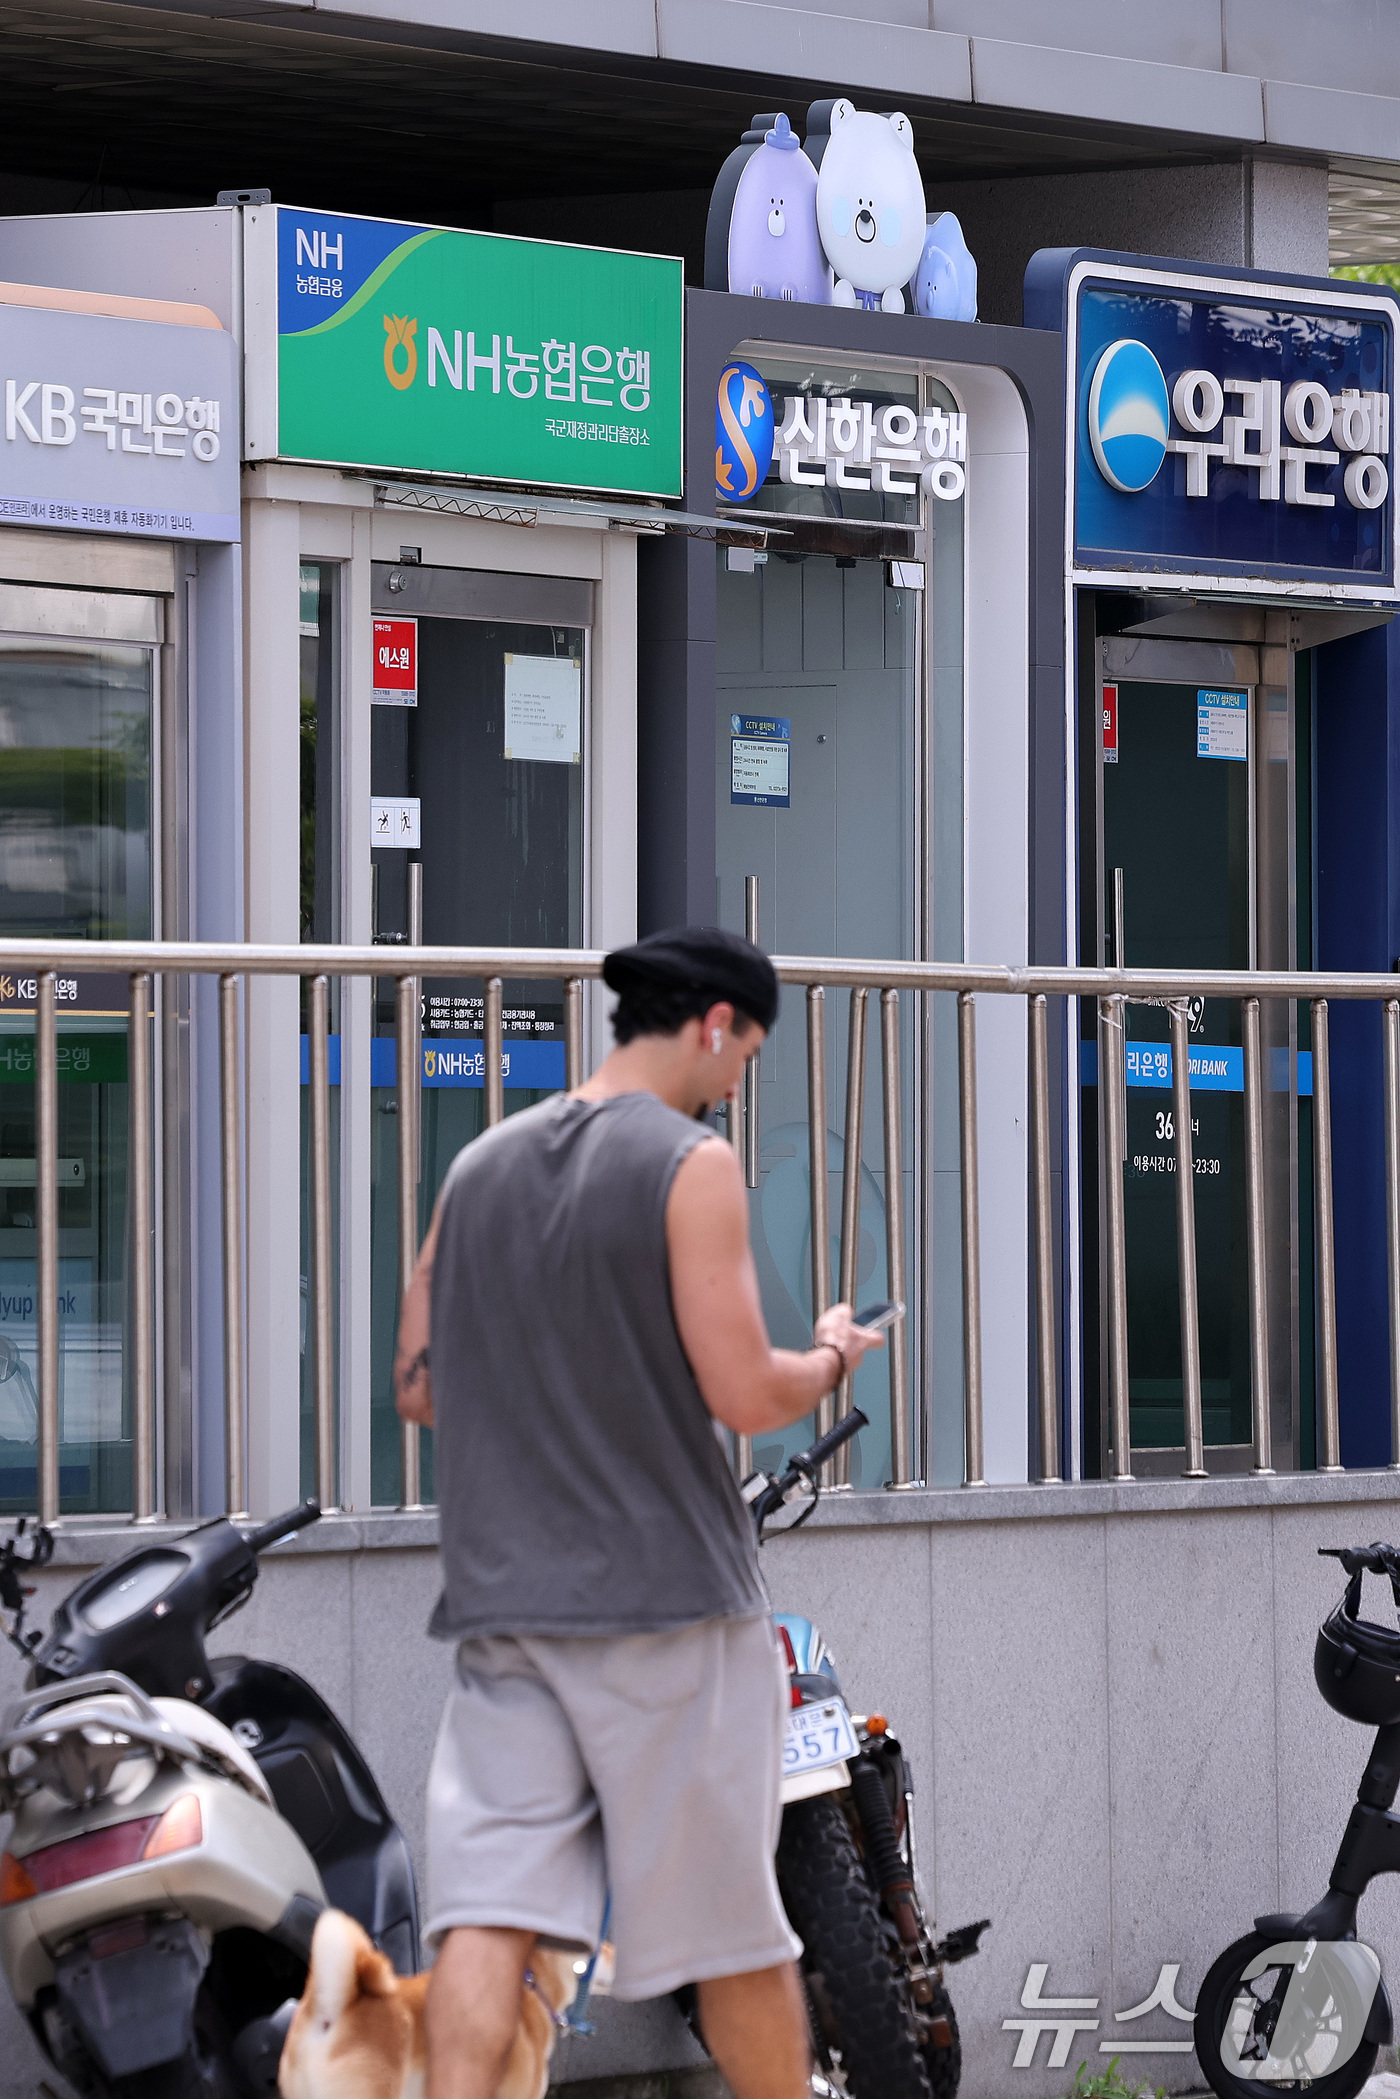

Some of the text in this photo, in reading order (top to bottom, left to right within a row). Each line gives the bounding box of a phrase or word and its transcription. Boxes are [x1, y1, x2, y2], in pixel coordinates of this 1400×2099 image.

[296, 228, 344, 271] NH
[296, 273, 344, 299] 농협금융
[426, 326, 652, 413] NH농협은행
[5, 379, 220, 462] KB국민은행
[545, 418, 651, 446] 국군재정관리단출장소
[774, 396, 967, 501] 신한은행
[1166, 370, 1391, 510] 우리은행
[48, 504, 79, 521] 운영하는
[81, 507, 111, 525] 국민은행
[113, 510, 128, 526] 제휴
[131, 512, 168, 529] 자동화기기
[170, 515, 195, 532] 입니다.
[379, 646, 410, 670] 에스원
[1204, 693, 1240, 707] CCTV 설치안내
[745, 721, 758, 730] CCTV
[438, 1052, 510, 1077] NH농협행
[1127, 1051, 1168, 1078] 리은행
[1201, 1059, 1228, 1076] BANK
[1155, 1111, 1175, 1140] 36
[1133, 1155, 1165, 1172] 이용시간
